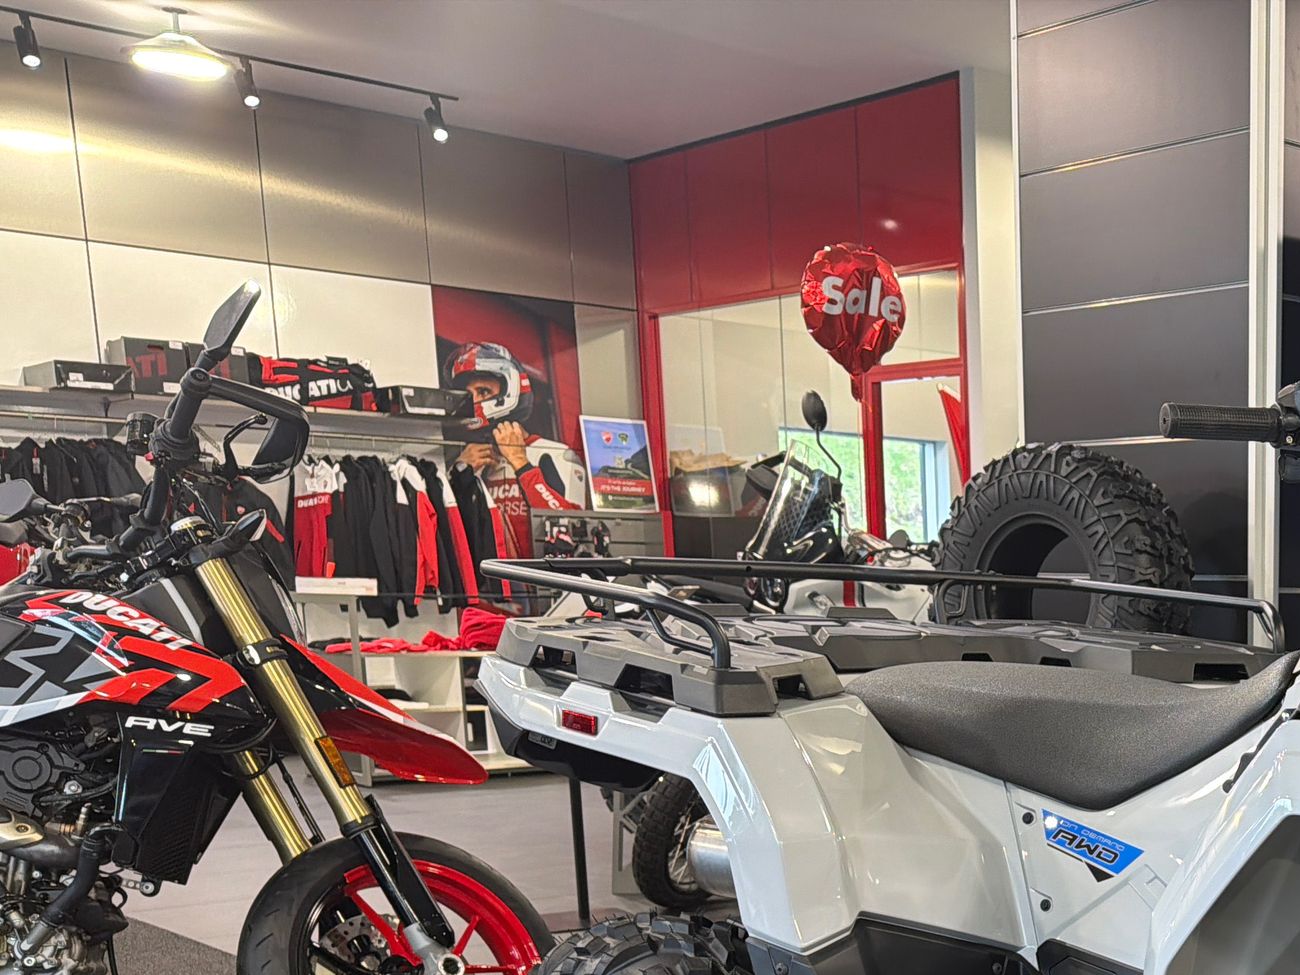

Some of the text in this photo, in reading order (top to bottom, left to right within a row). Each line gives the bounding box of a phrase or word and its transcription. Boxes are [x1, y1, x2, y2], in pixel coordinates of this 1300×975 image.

[822, 276, 902, 323] Sale
[59, 591, 194, 651] DUCATI
[1050, 828, 1120, 866] AWD
